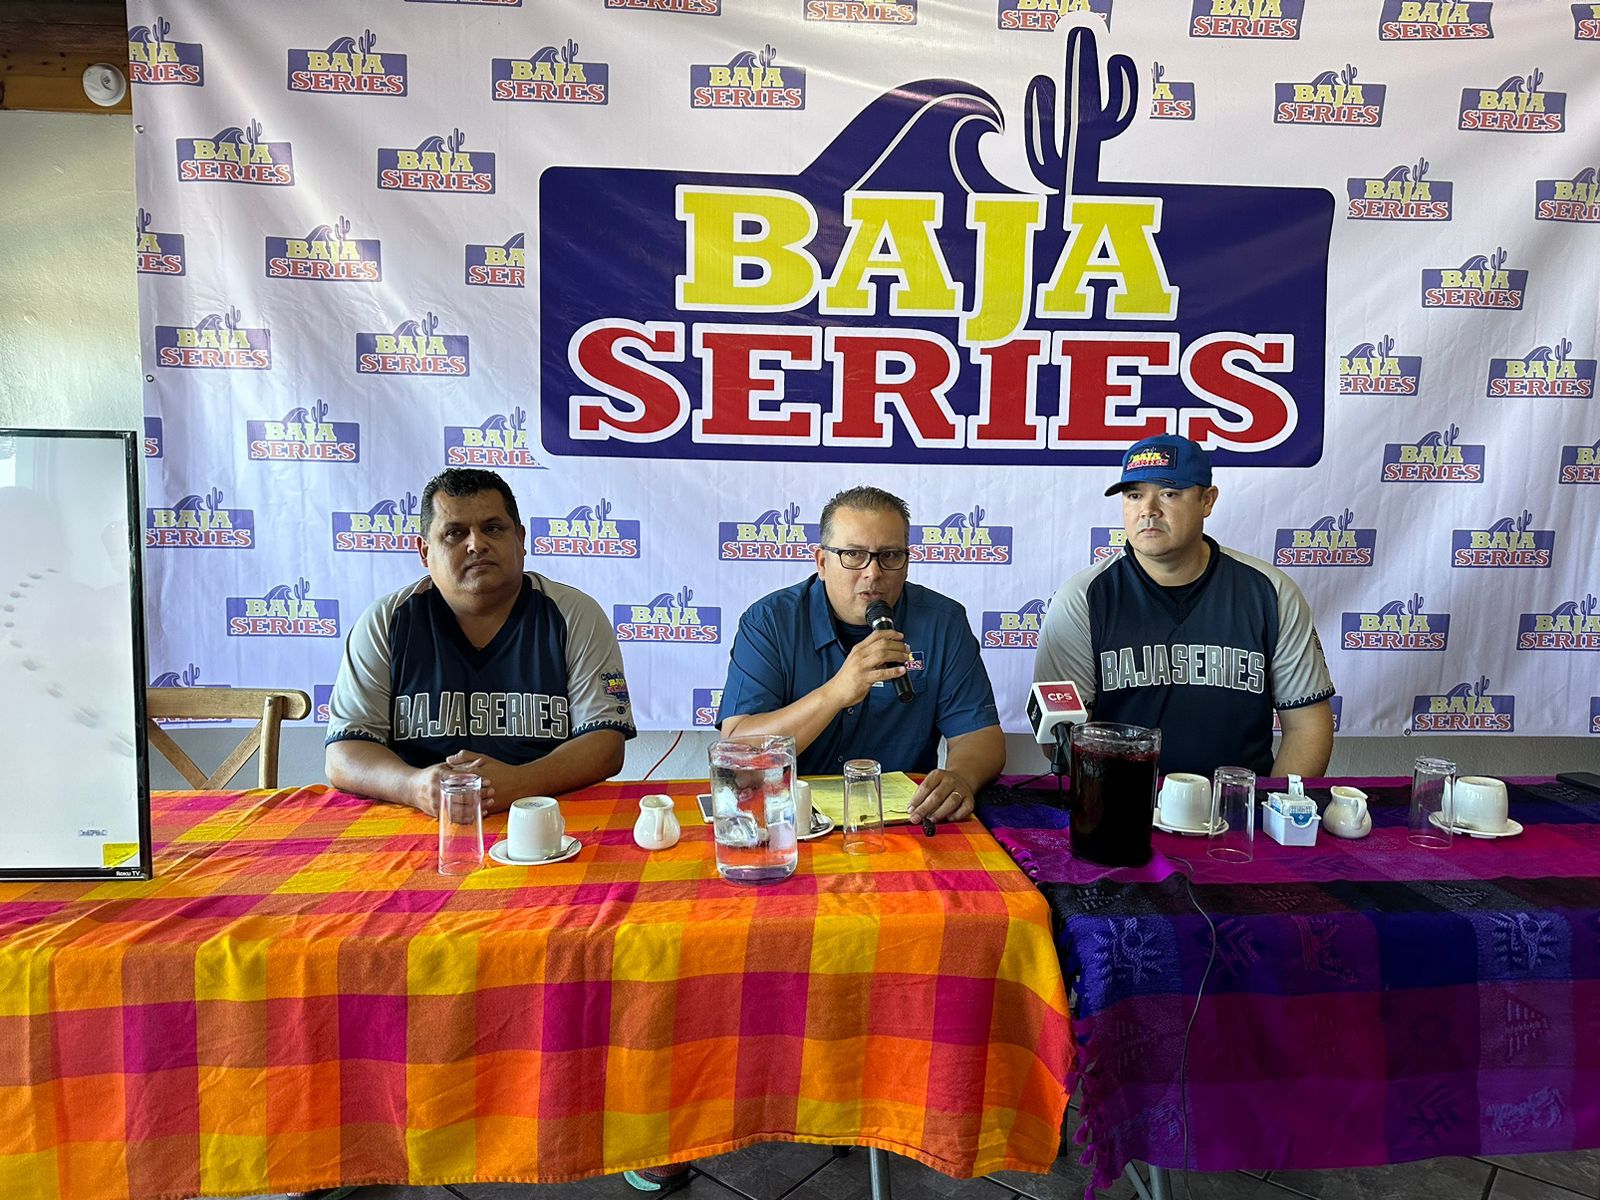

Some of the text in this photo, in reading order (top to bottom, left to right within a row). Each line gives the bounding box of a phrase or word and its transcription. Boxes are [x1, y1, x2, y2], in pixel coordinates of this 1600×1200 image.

[807, 2, 914, 22] SERIES
[1001, 10, 1058, 30] SER
[1210, 0, 1281, 20] BAJA
[1399, 0, 1469, 25] BAJA
[1193, 17, 1297, 37] SERIES
[1381, 21, 1490, 39] SERIES
[130, 42, 178, 67] AJA
[307, 52, 385, 75] BAJA
[130, 63, 199, 83] RIES
[291, 72, 404, 94] SERIES
[510, 60, 586, 86] BAJA
[710, 67, 782, 91] BAJA
[495, 80, 605, 103] SERIES
[693, 88, 802, 108] SERIES
[1293, 84, 1364, 107] BAJA
[1479, 90, 1545, 115] BAJA
[1277, 103, 1379, 125] SERIES
[1461, 110, 1561, 131] SERIES
[193, 140, 273, 166] BAJA
[397, 150, 474, 175] BAJA
[180, 161, 291, 184] SERIES
[381, 171, 491, 192] SERIES
[1365, 180, 1431, 203] BAJA
[1554, 182, 1600, 205] BAJ
[1348, 200, 1449, 219] SERIES
[1538, 200, 1600, 220] SERI
[286, 240, 360, 264] BAJA
[485, 247, 524, 267] BA
[269, 259, 379, 280] SERIES
[468, 266, 524, 286] SER
[676, 185, 1179, 349] BAJA
[1440, 270, 1509, 292] BAJA
[1424, 289, 1521, 308] SERIES
[177, 329, 251, 353] BAJA
[376, 336, 448, 359] BAJA
[160, 348, 268, 369] SERIES
[359, 354, 467, 375] SERIES
[1505, 360, 1577, 382] BAJA
[569, 318, 1299, 452] SERIES
[1340, 376, 1416, 394] ERIES
[1489, 378, 1592, 397] SERIES
[265, 422, 337, 445] BAJA
[250, 442, 356, 462] SERIES
[448, 447, 531, 468] SERIE
[1399, 446, 1463, 467] BAJA
[1383, 464, 1481, 482] SERIES
[153, 509, 233, 531] BAJA
[350, 514, 420, 536] BAJA
[549, 520, 620, 541] BAJA
[146, 528, 252, 547] SERIES
[335, 531, 419, 552] SERIE
[737, 524, 807, 545] BAJA
[921, 527, 992, 548] BAJA
[1292, 531, 1357, 551] BAJA
[1470, 532, 1536, 552] BAJA
[534, 538, 638, 557] SERIES
[722, 542, 818, 559] SERIES
[908, 544, 1008, 563] SERIES
[1276, 547, 1371, 565] SERIES
[1455, 549, 1550, 567] SERIES
[245, 599, 319, 619] BAJA
[631, 607, 701, 627] BAJA
[229, 618, 337, 636] SERIES
[616, 624, 718, 642] SERIES
[1000, 614, 1040, 632] BA
[1360, 615, 1430, 636] BAJA
[1536, 615, 1600, 636] BAJA
[984, 631, 1038, 647] SER
[1344, 632, 1445, 650] SERIES
[1520, 632, 1600, 650] SERIE
[1048, 692, 1072, 702] CPS
[1429, 697, 1495, 715] BAJA
[394, 692, 568, 741] BAJA SERIES
[1414, 714, 1511, 731] SERIES
